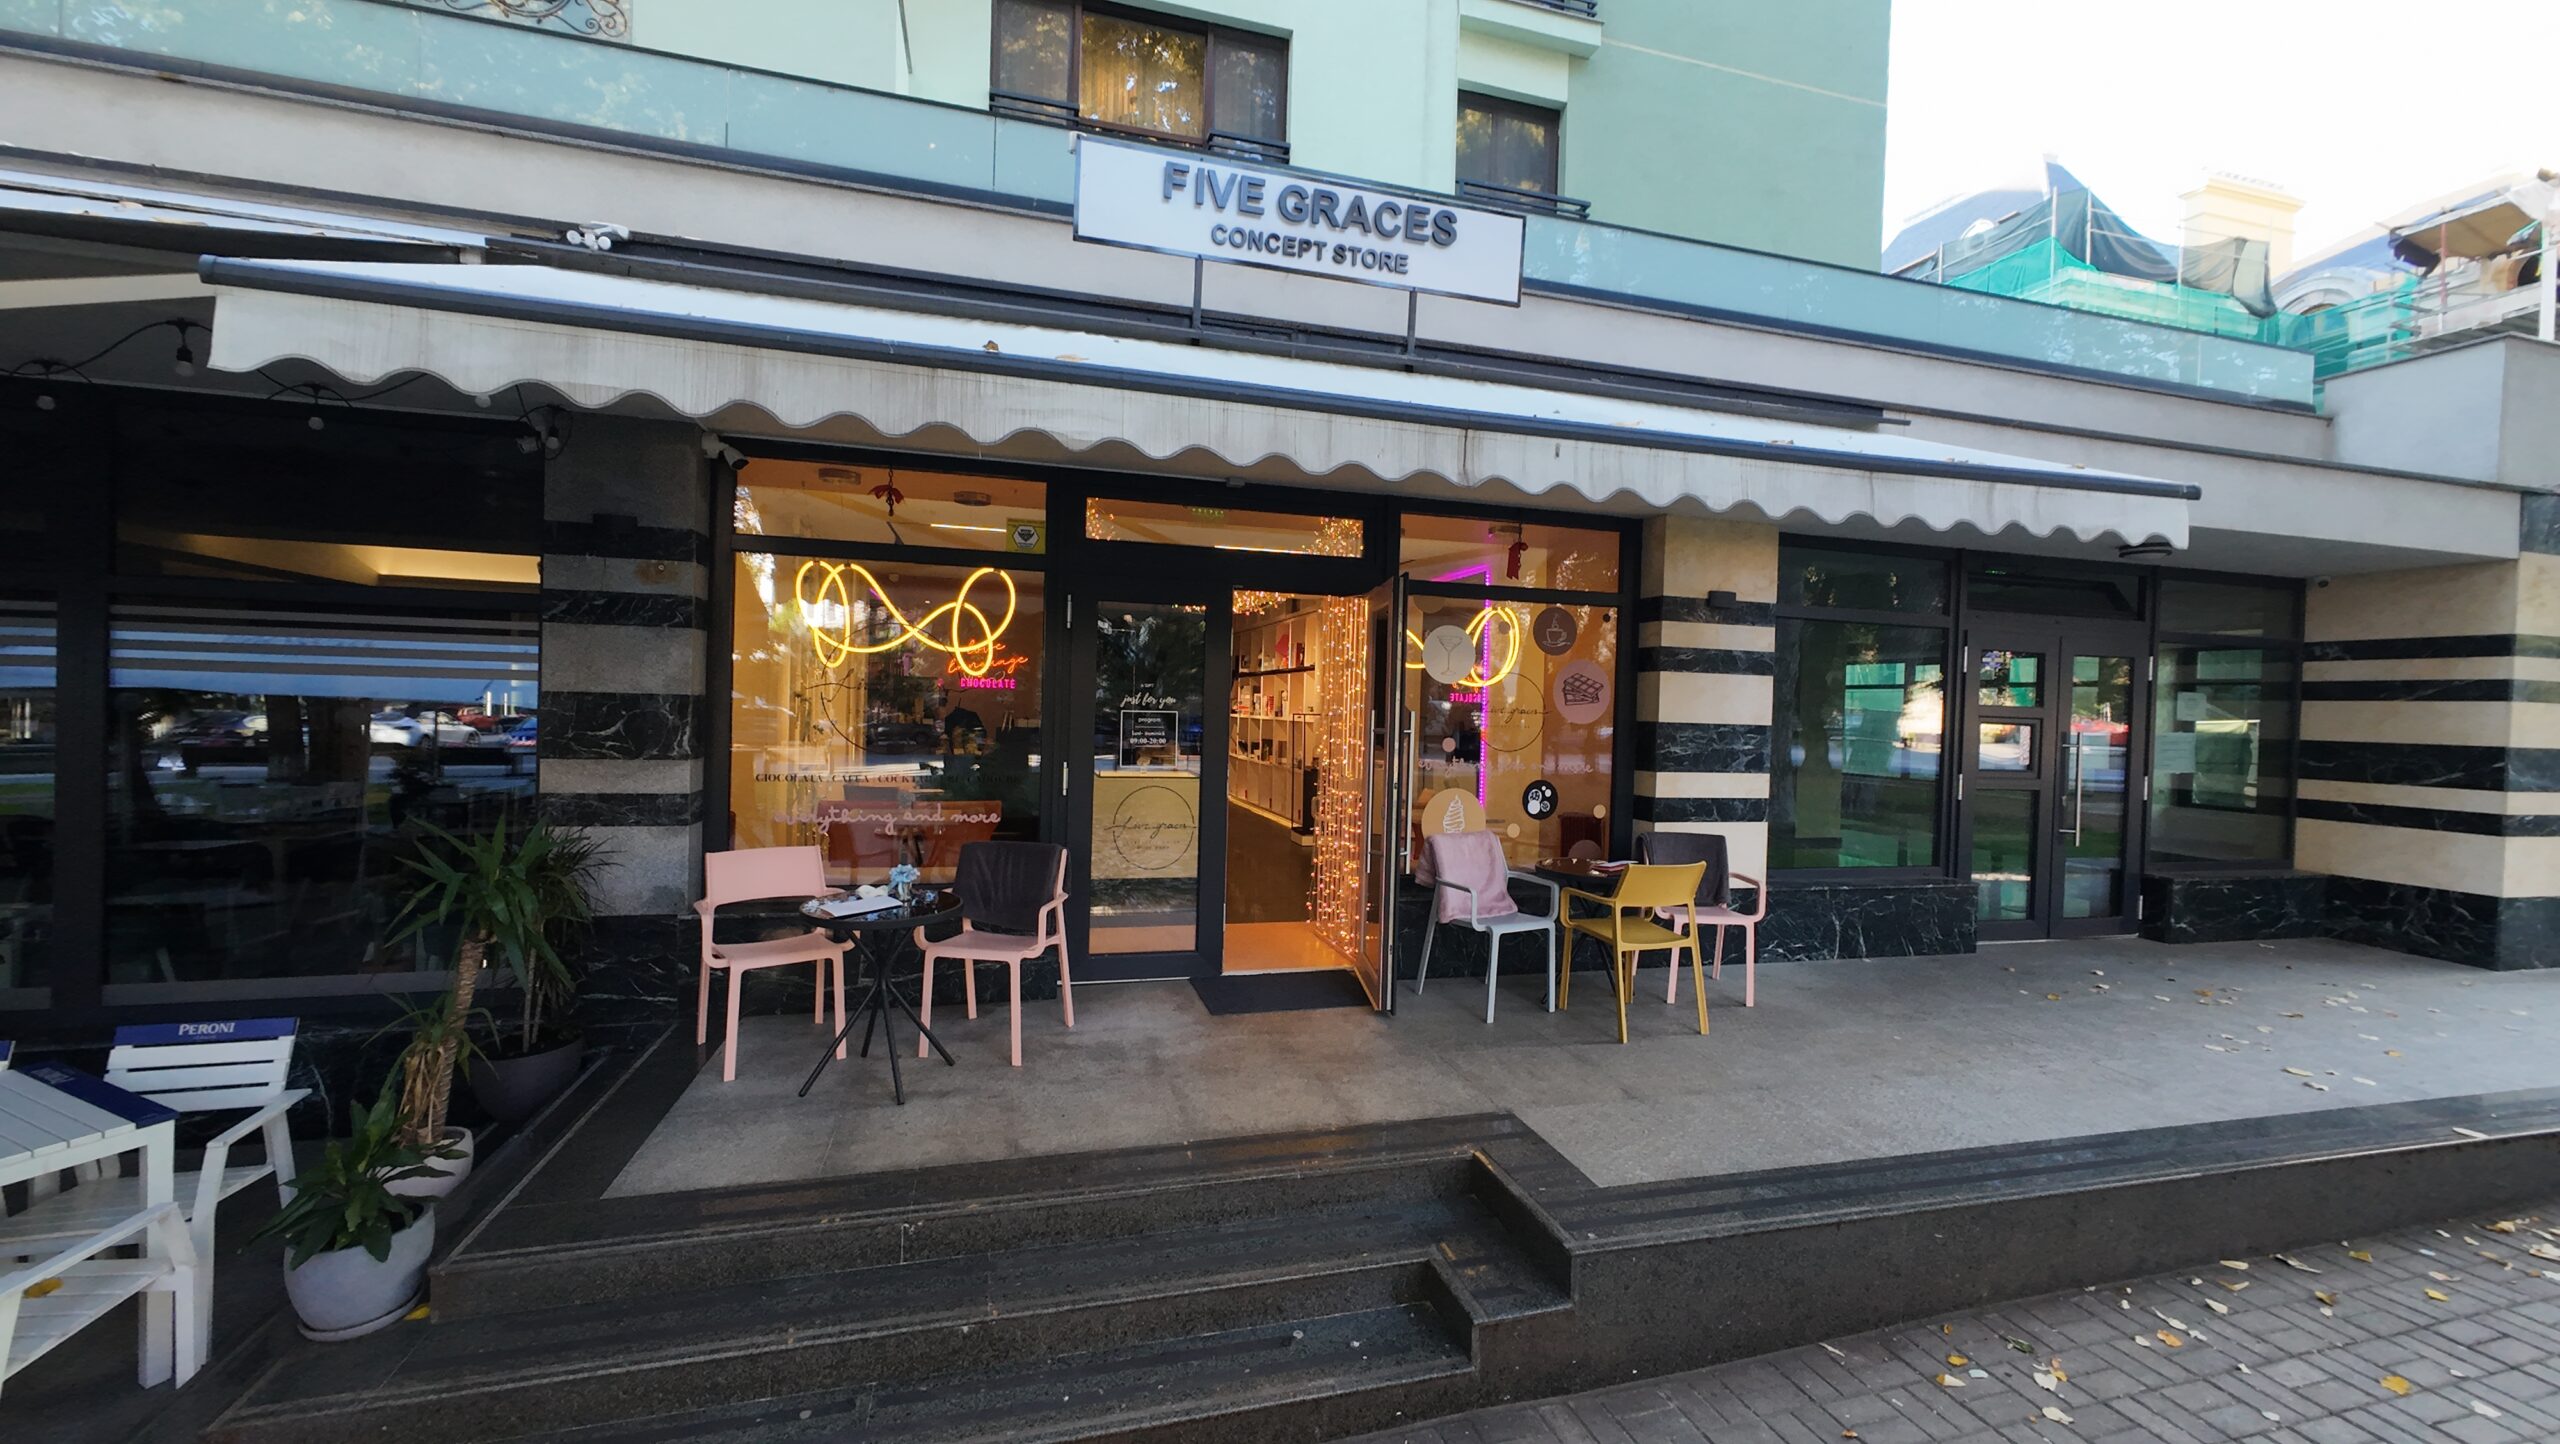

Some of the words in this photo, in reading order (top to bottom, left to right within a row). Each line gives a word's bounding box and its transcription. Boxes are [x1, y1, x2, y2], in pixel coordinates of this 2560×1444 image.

[1162, 160, 1267, 216] FIVE
[1277, 184, 1458, 246] GRACES
[1210, 223, 1328, 262] CONCEPT
[1332, 243, 1409, 275] STORE
[960, 677, 1017, 690] CHOCOLATE
[1119, 692, 1142, 708] just
[1142, 692, 1157, 706] for
[1159, 696, 1177, 709] you
[903, 803, 942, 823] and
[950, 811, 1002, 824] more
[178, 1022, 236, 1036] PERONI
